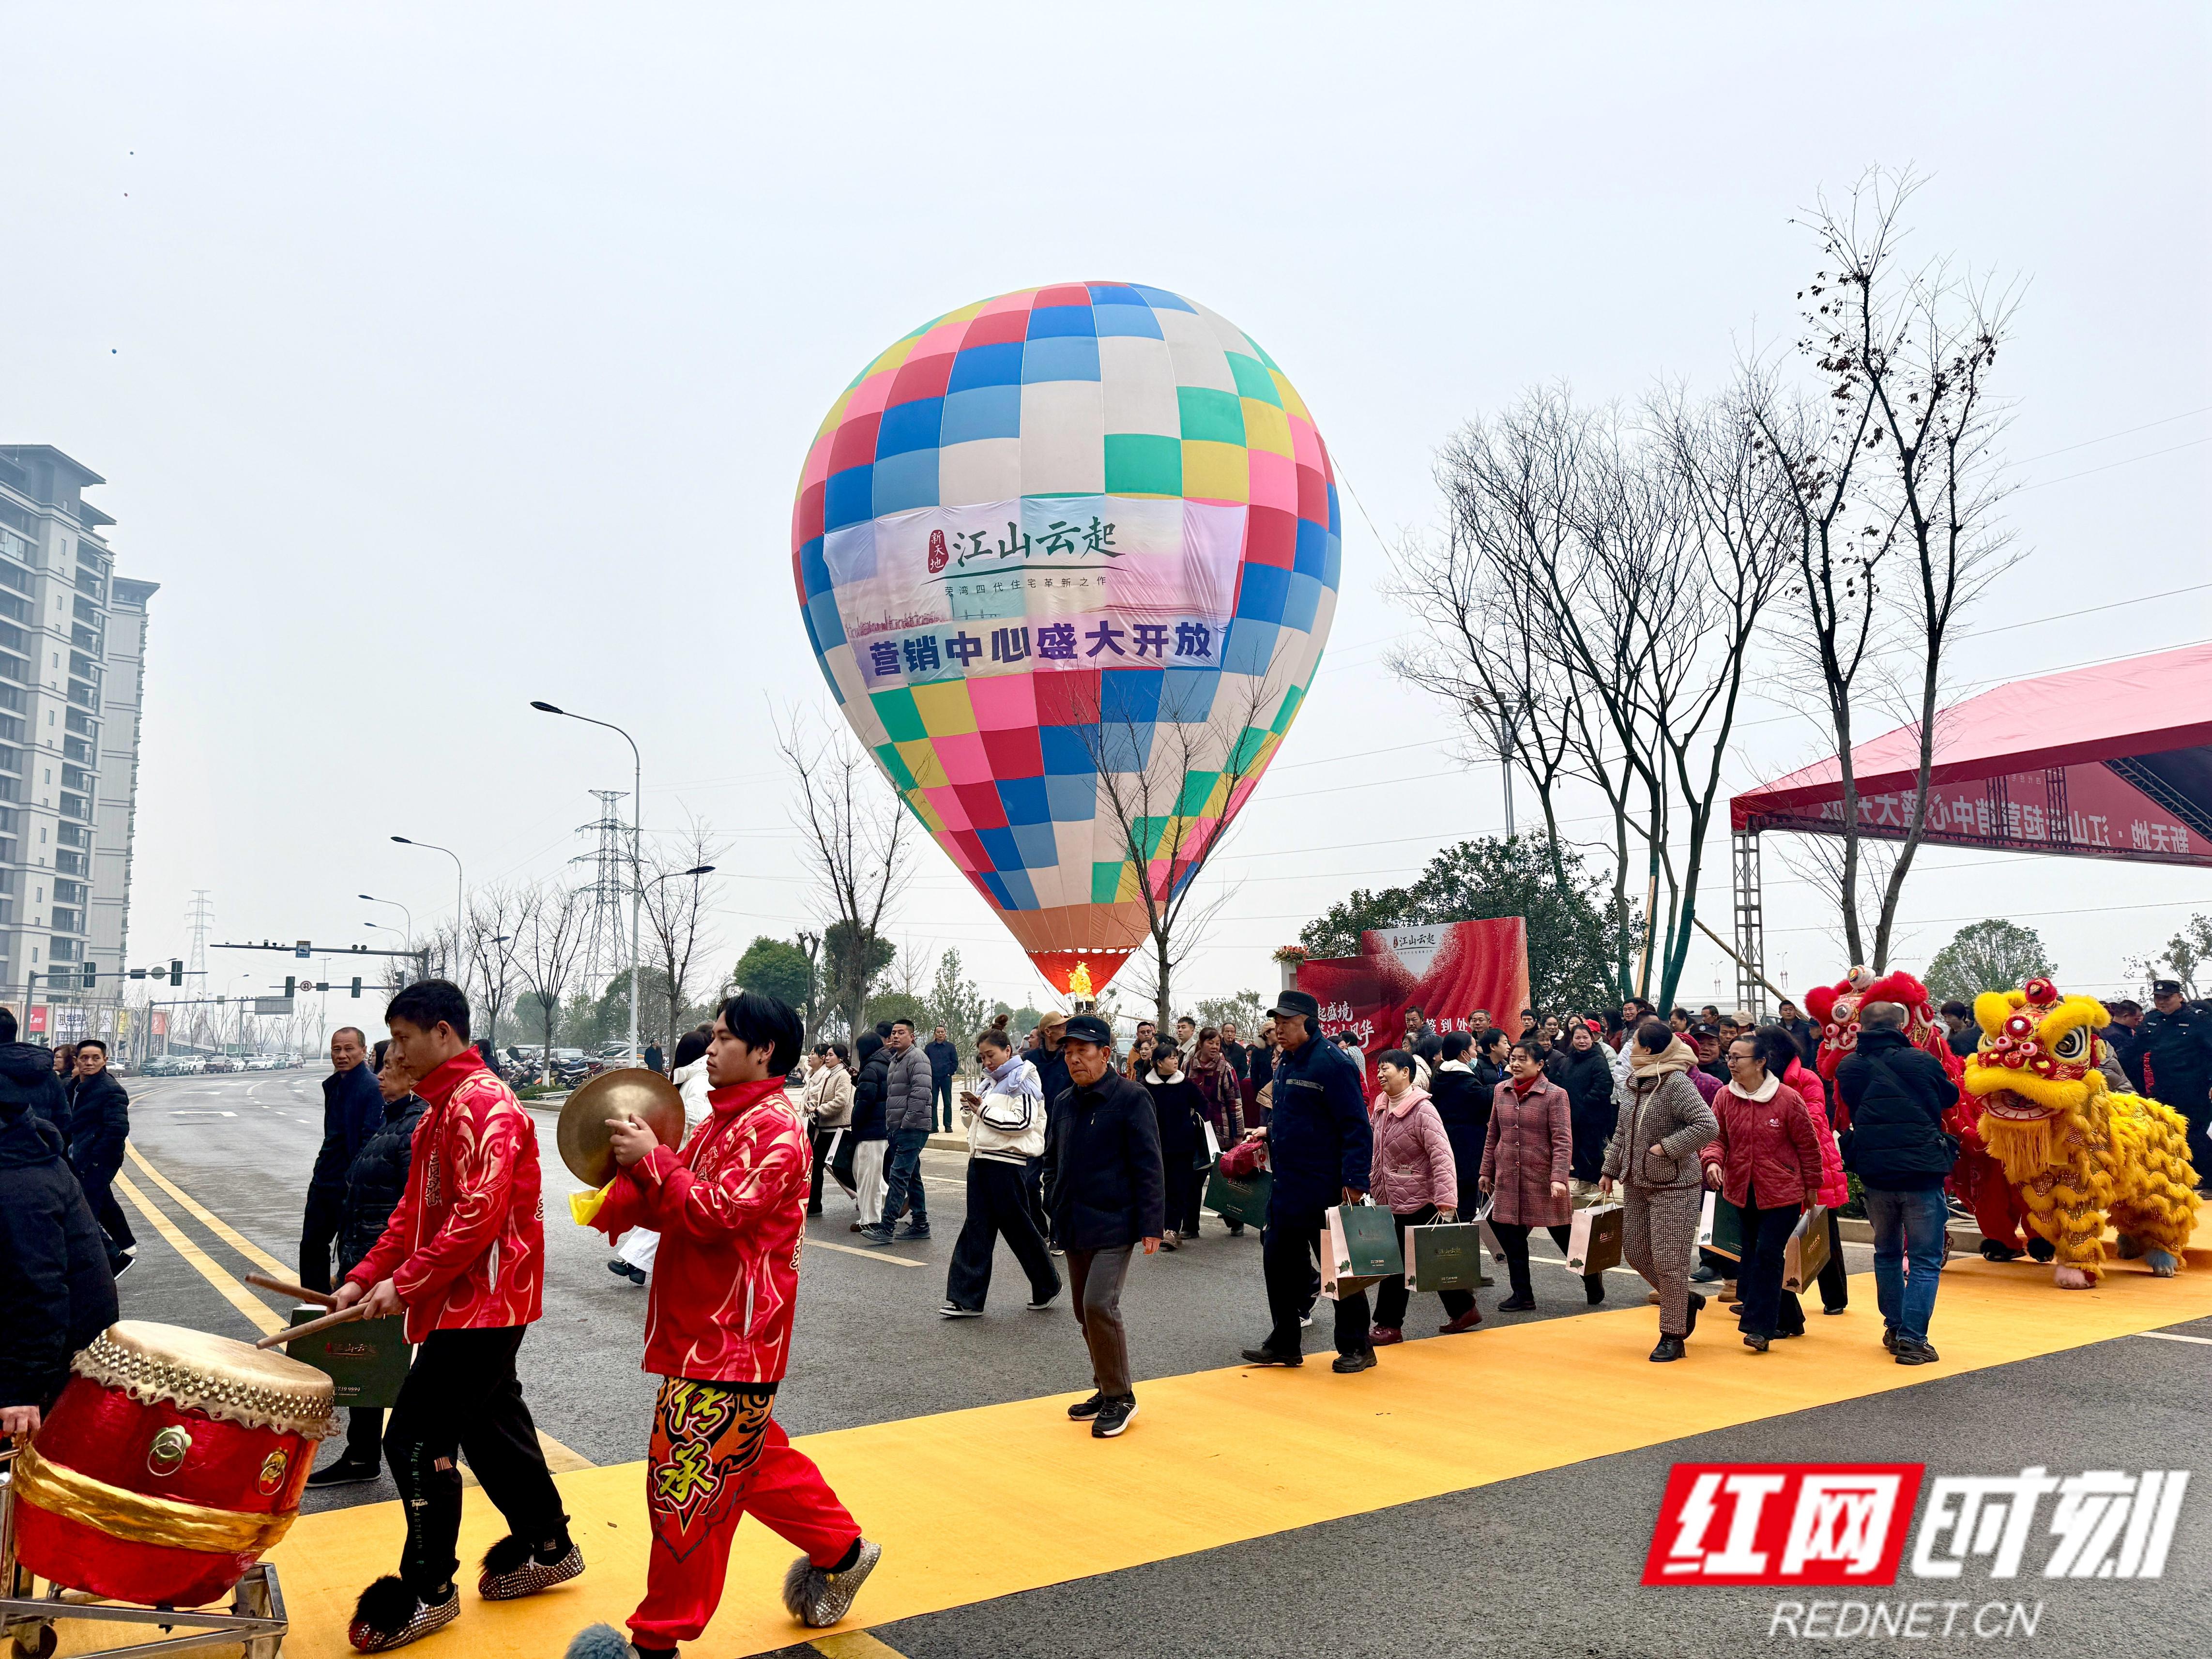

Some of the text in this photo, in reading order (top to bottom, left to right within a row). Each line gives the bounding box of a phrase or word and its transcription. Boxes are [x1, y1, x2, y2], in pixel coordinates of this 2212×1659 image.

[930, 532, 946, 570] 新天地
[952, 516, 1126, 567] 江山云起
[945, 576, 1107, 596] 荣湾四代住宅革新之作
[870, 620, 1212, 676] 营销中心盛大开放
[1399, 932, 1436, 947] 江山云起
[659, 1382, 728, 1501] 传承
